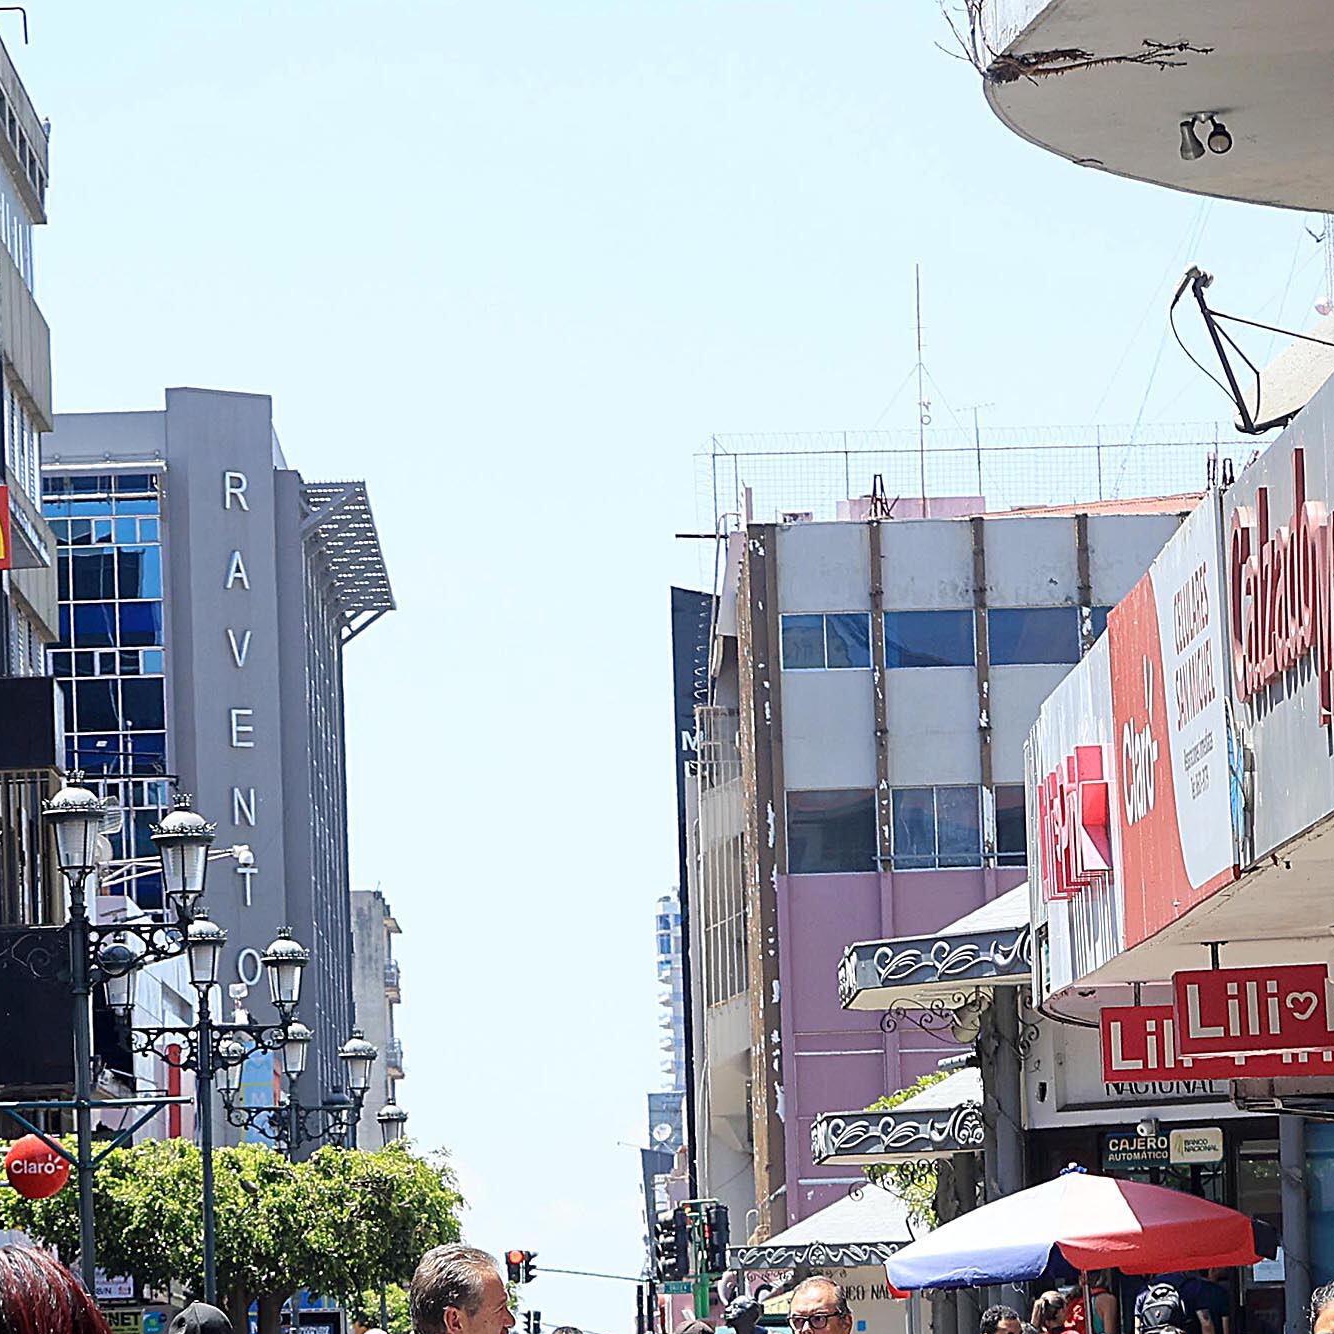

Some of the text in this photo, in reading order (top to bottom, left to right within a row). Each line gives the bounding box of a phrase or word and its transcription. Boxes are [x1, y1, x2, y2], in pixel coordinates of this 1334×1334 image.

[1123, 717, 1155, 828] Claro
[1186, 980, 1281, 1040] Lili
[1110, 1018, 1193, 1071] Lil
[1109, 1136, 1168, 1152] CAJERO
[1108, 1150, 1169, 1162] AUTOMÁTICO
[10, 1159, 56, 1175] Claro
[103, 1311, 142, 1327] NET
